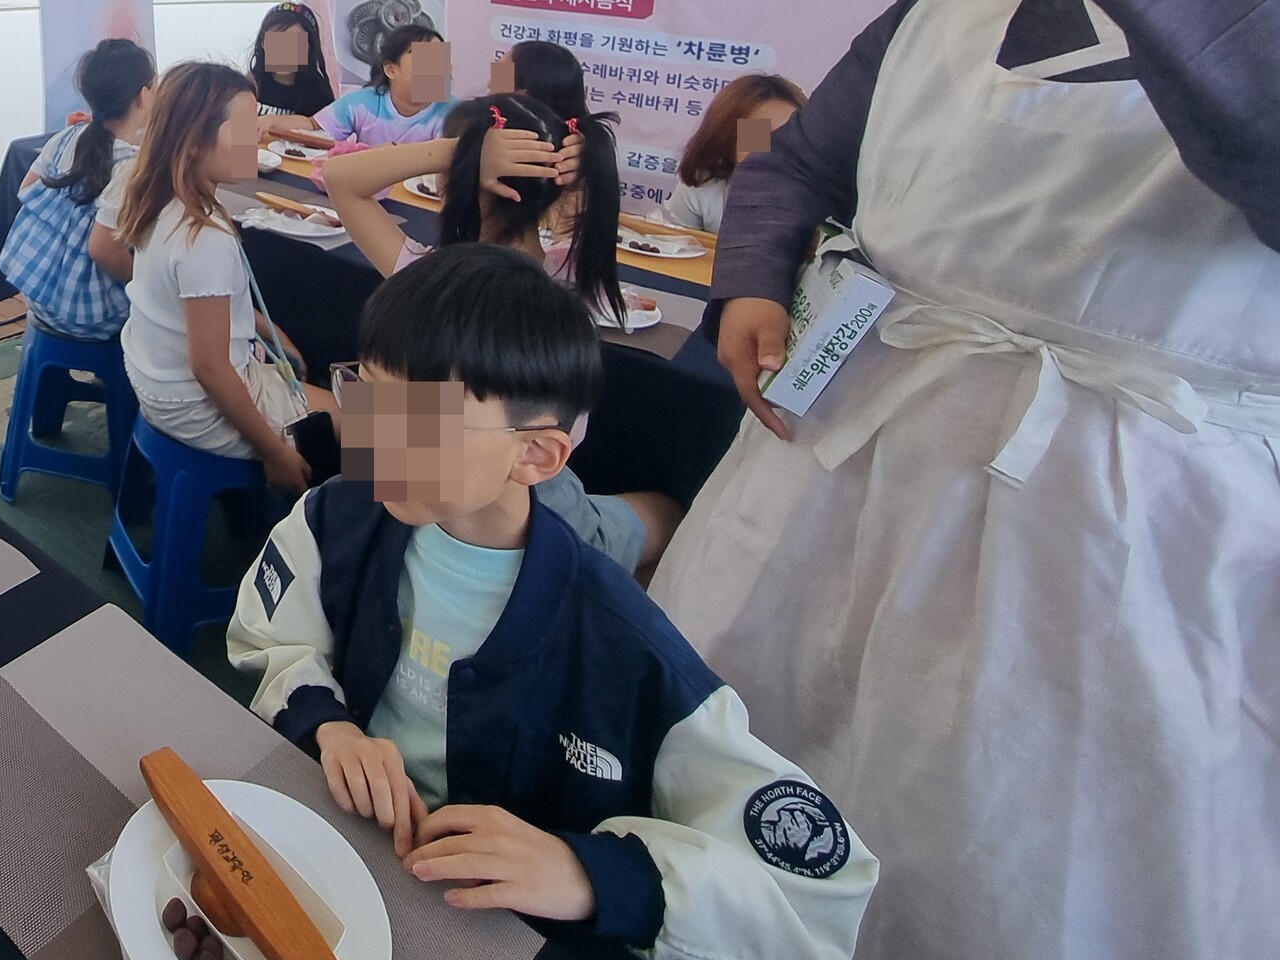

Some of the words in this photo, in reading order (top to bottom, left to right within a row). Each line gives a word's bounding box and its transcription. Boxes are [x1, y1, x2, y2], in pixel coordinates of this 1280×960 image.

[500, 23, 542, 42] 건강과
[547, 28, 595, 49] 화평을
[600, 35, 669, 57] 기원하는
[611, 90, 679, 114] 수레바퀴
[686, 100, 703, 117] 등
[627, 151, 677, 174] 갈증을
[559, 734, 597, 767] NORTH
[571, 732, 596, 756] THE
[566, 750, 596, 776] FACE
[750, 800, 764, 817] THE
[761, 786, 794, 803] NORTH
[796, 787, 822, 805] FACE
